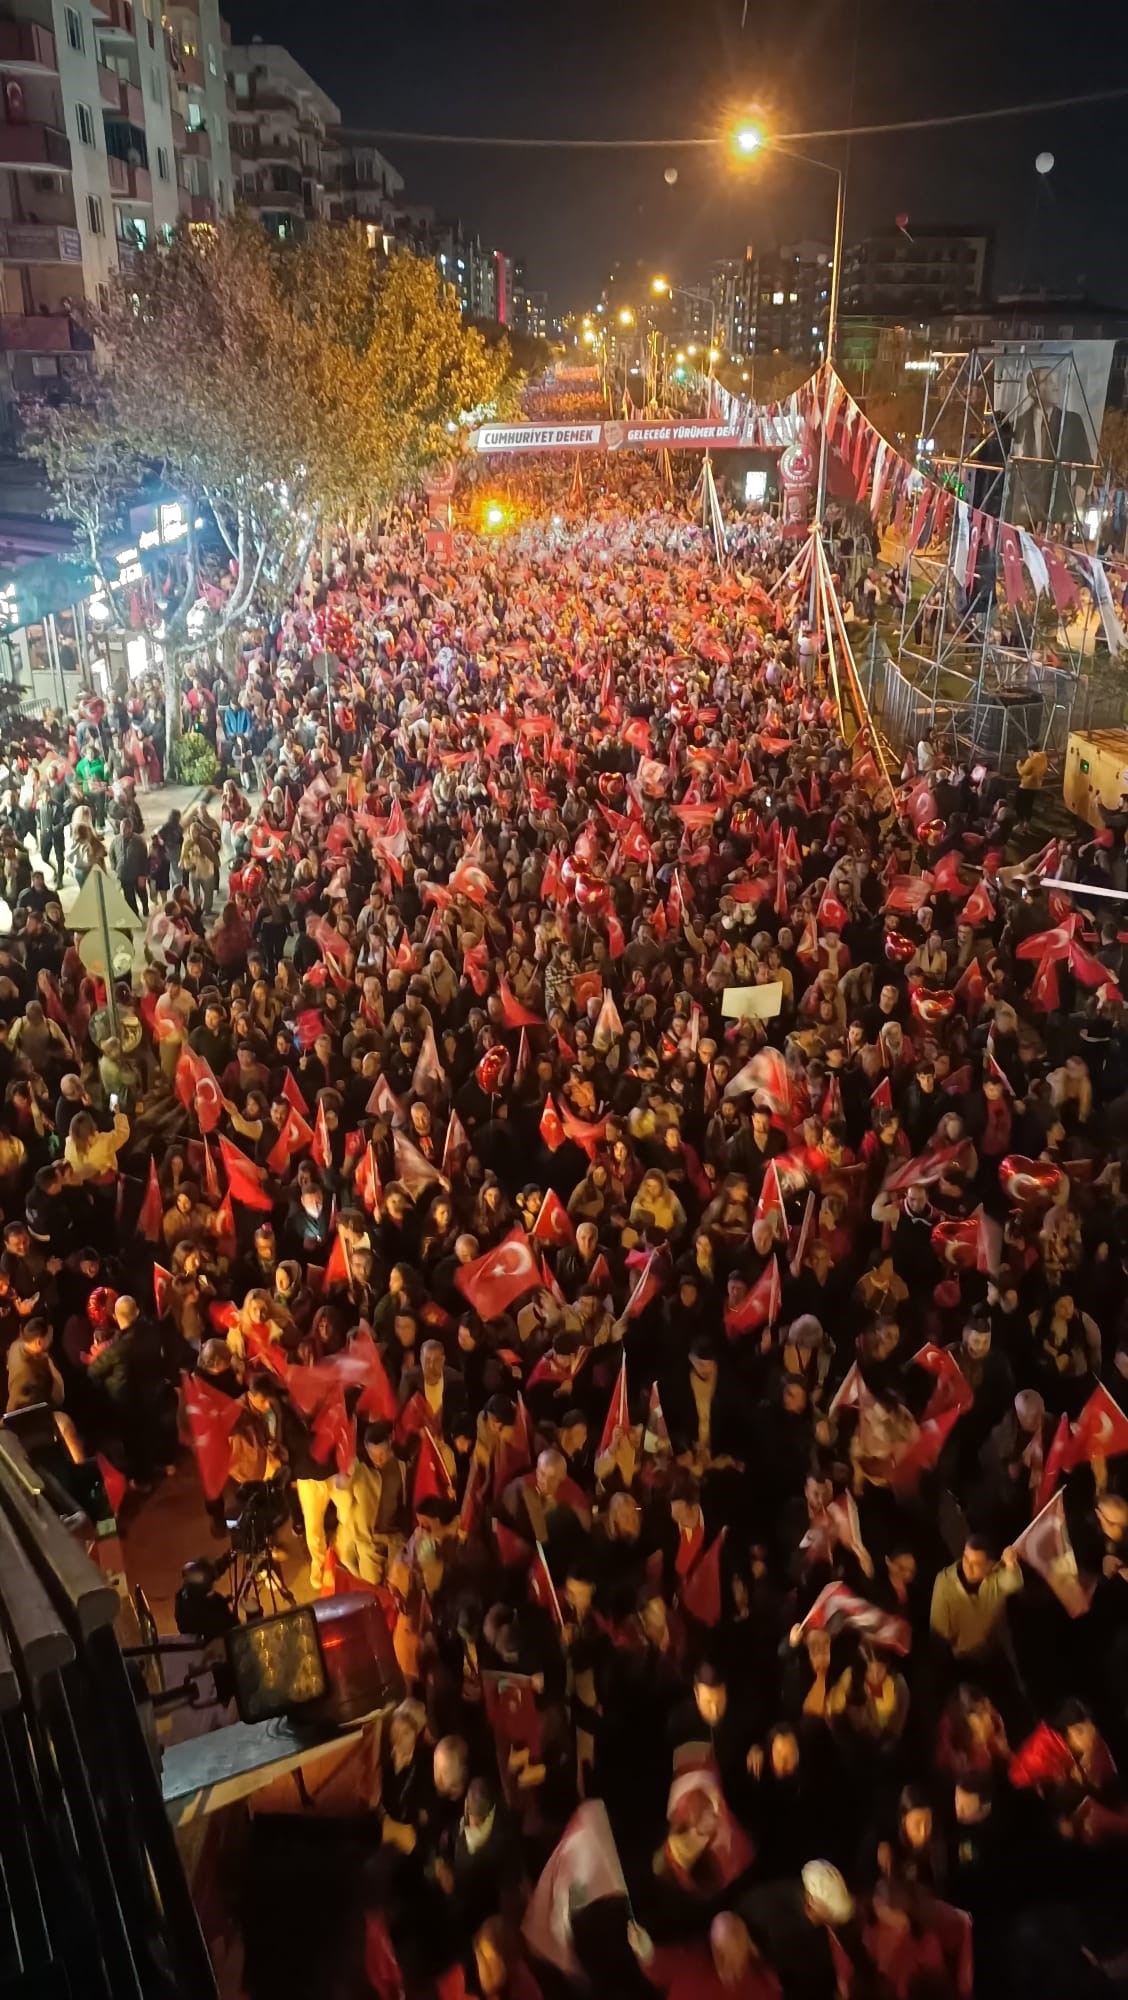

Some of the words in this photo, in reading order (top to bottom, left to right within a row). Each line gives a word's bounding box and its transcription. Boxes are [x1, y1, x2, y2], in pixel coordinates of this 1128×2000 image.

[485, 429, 554, 445] CUMHURİYET
[556, 429, 593, 442] DEMEK
[627, 427, 671, 441] GELECEĞE
[673, 425, 716, 439] YÜRÜMEK
